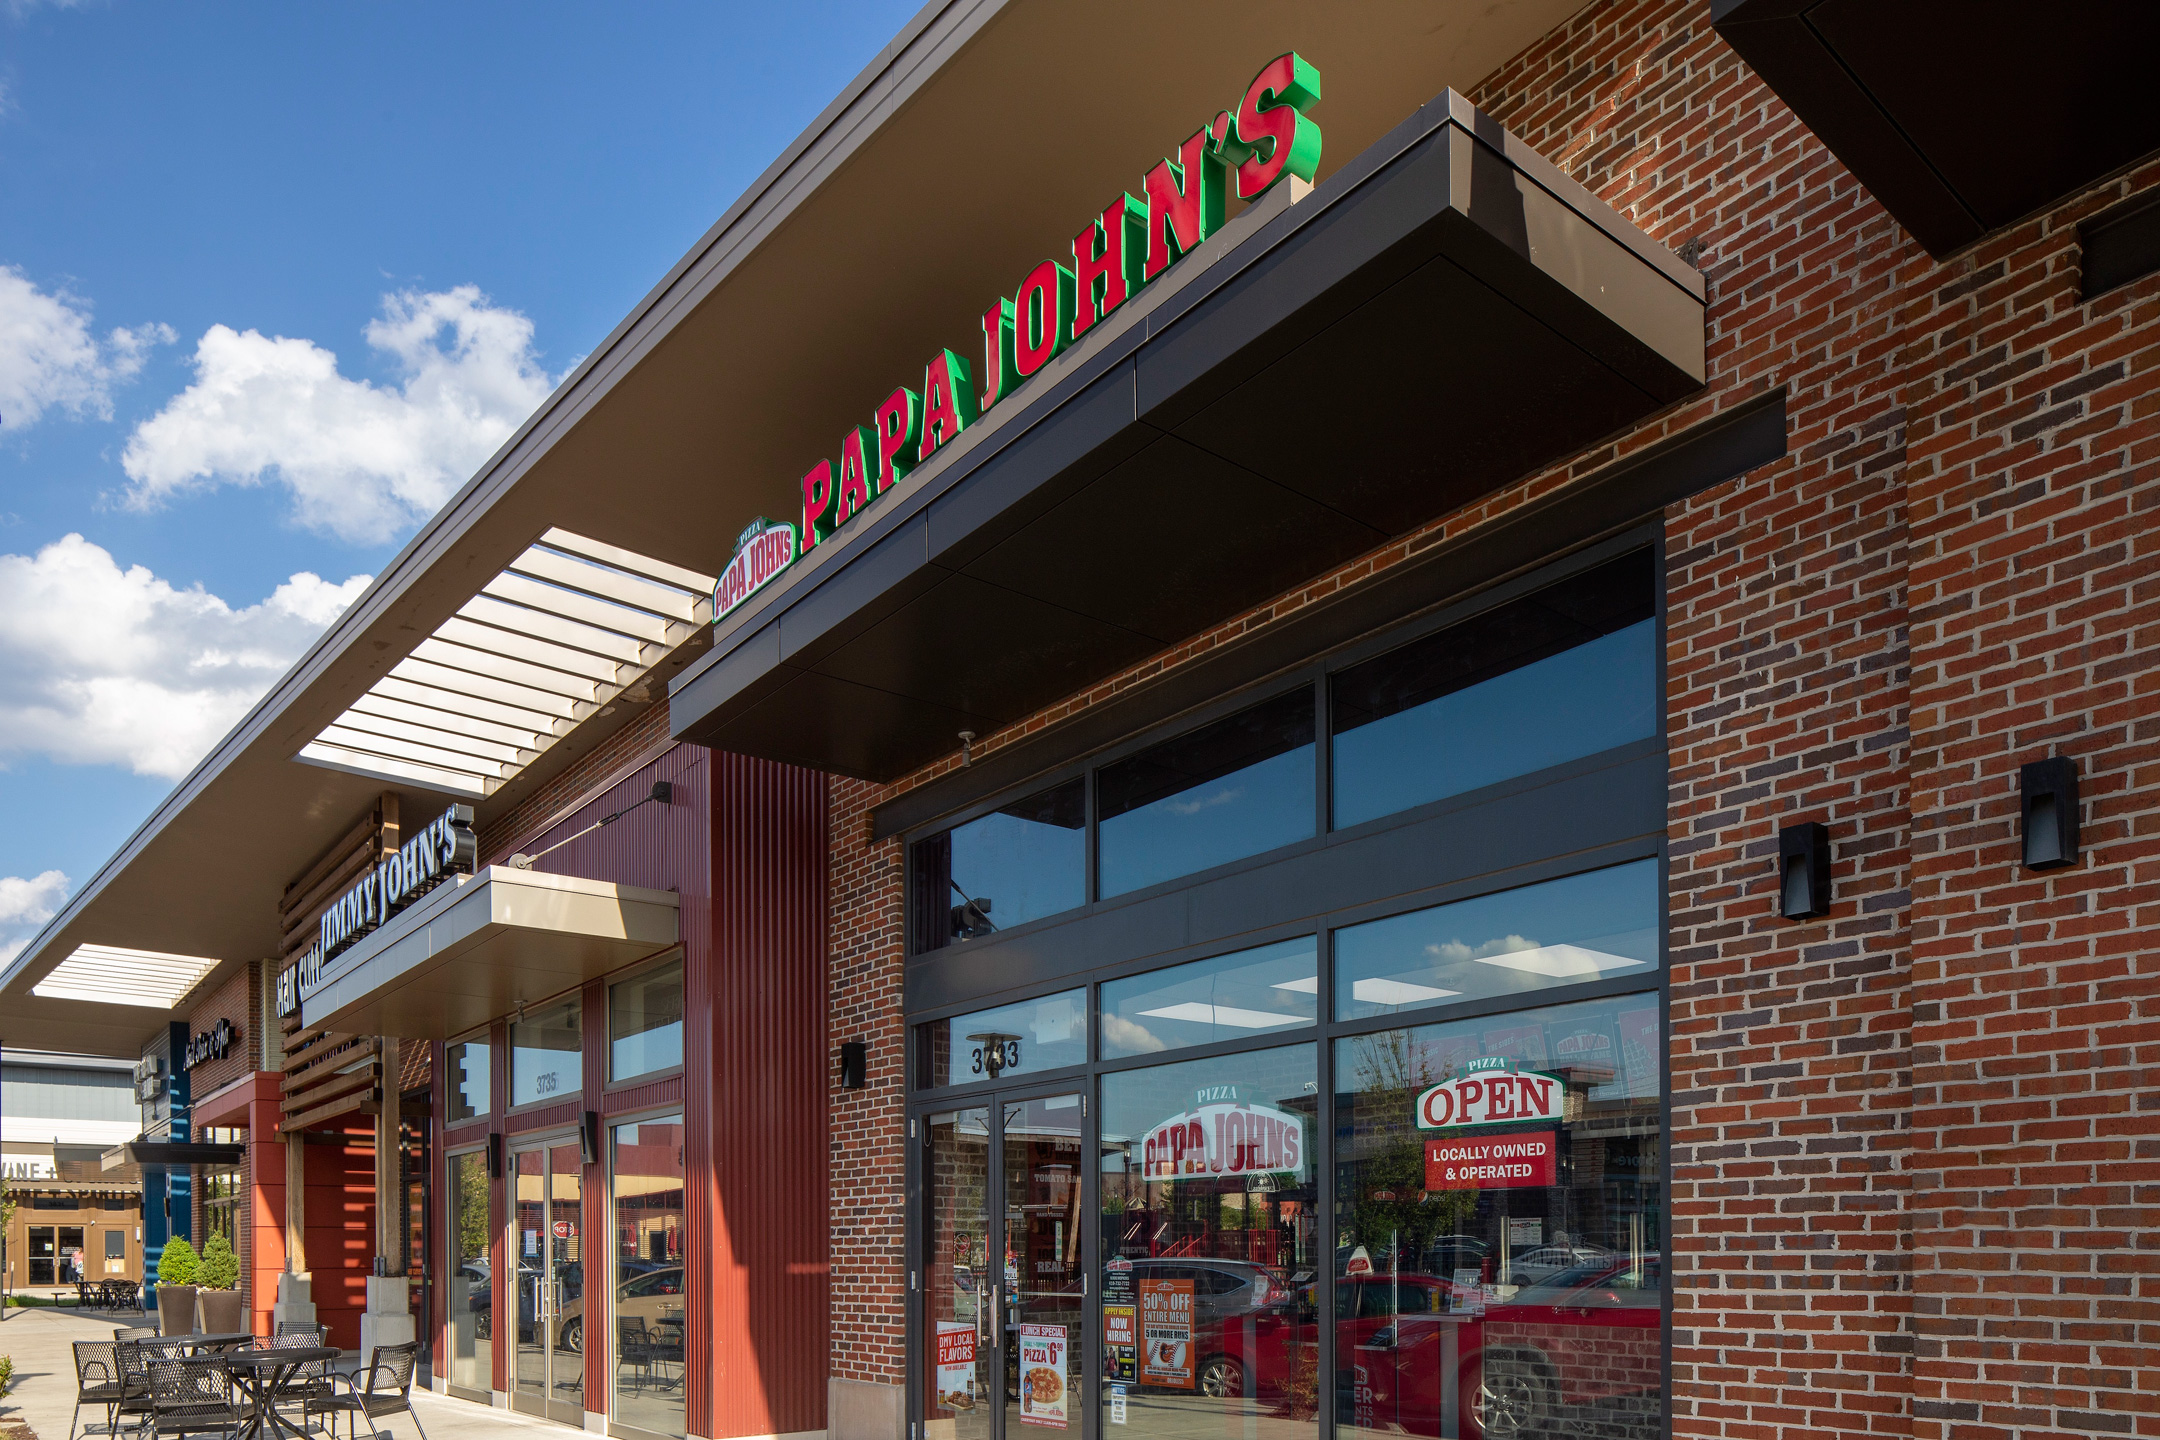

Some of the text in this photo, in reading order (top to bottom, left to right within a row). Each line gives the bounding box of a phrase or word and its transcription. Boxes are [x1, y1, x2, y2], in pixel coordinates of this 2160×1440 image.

[801, 51, 1319, 555] PAPA JOHN'S
[740, 521, 761, 546] PIZZA
[715, 554, 747, 618] PAPA
[320, 803, 473, 968] JIMMY JOHN'S
[277, 961, 298, 1019] Hair
[1641, 1026, 1652, 1036] THE
[971, 1041, 1019, 1075] 3733
[1468, 1057, 1505, 1072] PIZZA
[536, 1072, 557, 1095] 3735
[1197, 1086, 1237, 1102] PIZZA
[1423, 1076, 1554, 1127] OPEN
[1054, 1137, 1081, 1152] BET
[1144, 1111, 1299, 1177] PAPA JOHN'S
[1433, 1142, 1546, 1162] LOCALLY OWNED
[1034, 1173, 1081, 1183] TOMATO SA
[1445, 1163, 1533, 1181] & OPERATED
[1143, 1292, 1168, 1310] 50%
[1170, 1293, 1190, 1311] OFF
[1104, 1307, 1134, 1316] APPLY INSIDE
[1144, 1311, 1190, 1323] ENTIRE MENU
[1022, 1325, 1065, 1338] LUNCH SPECIAL
[1110, 1317, 1128, 1329] NOW
[939, 1332, 975, 1349] DMV LOCAL
[1107, 1330, 1132, 1342] HIRING
[1145, 1329, 1189, 1340] 5 OR MORE RUNS
[939, 1345, 973, 1363] FLAVORS
[1354, 1386, 1373, 1404] ER
[1355, 1405, 1374, 1417] NTS
